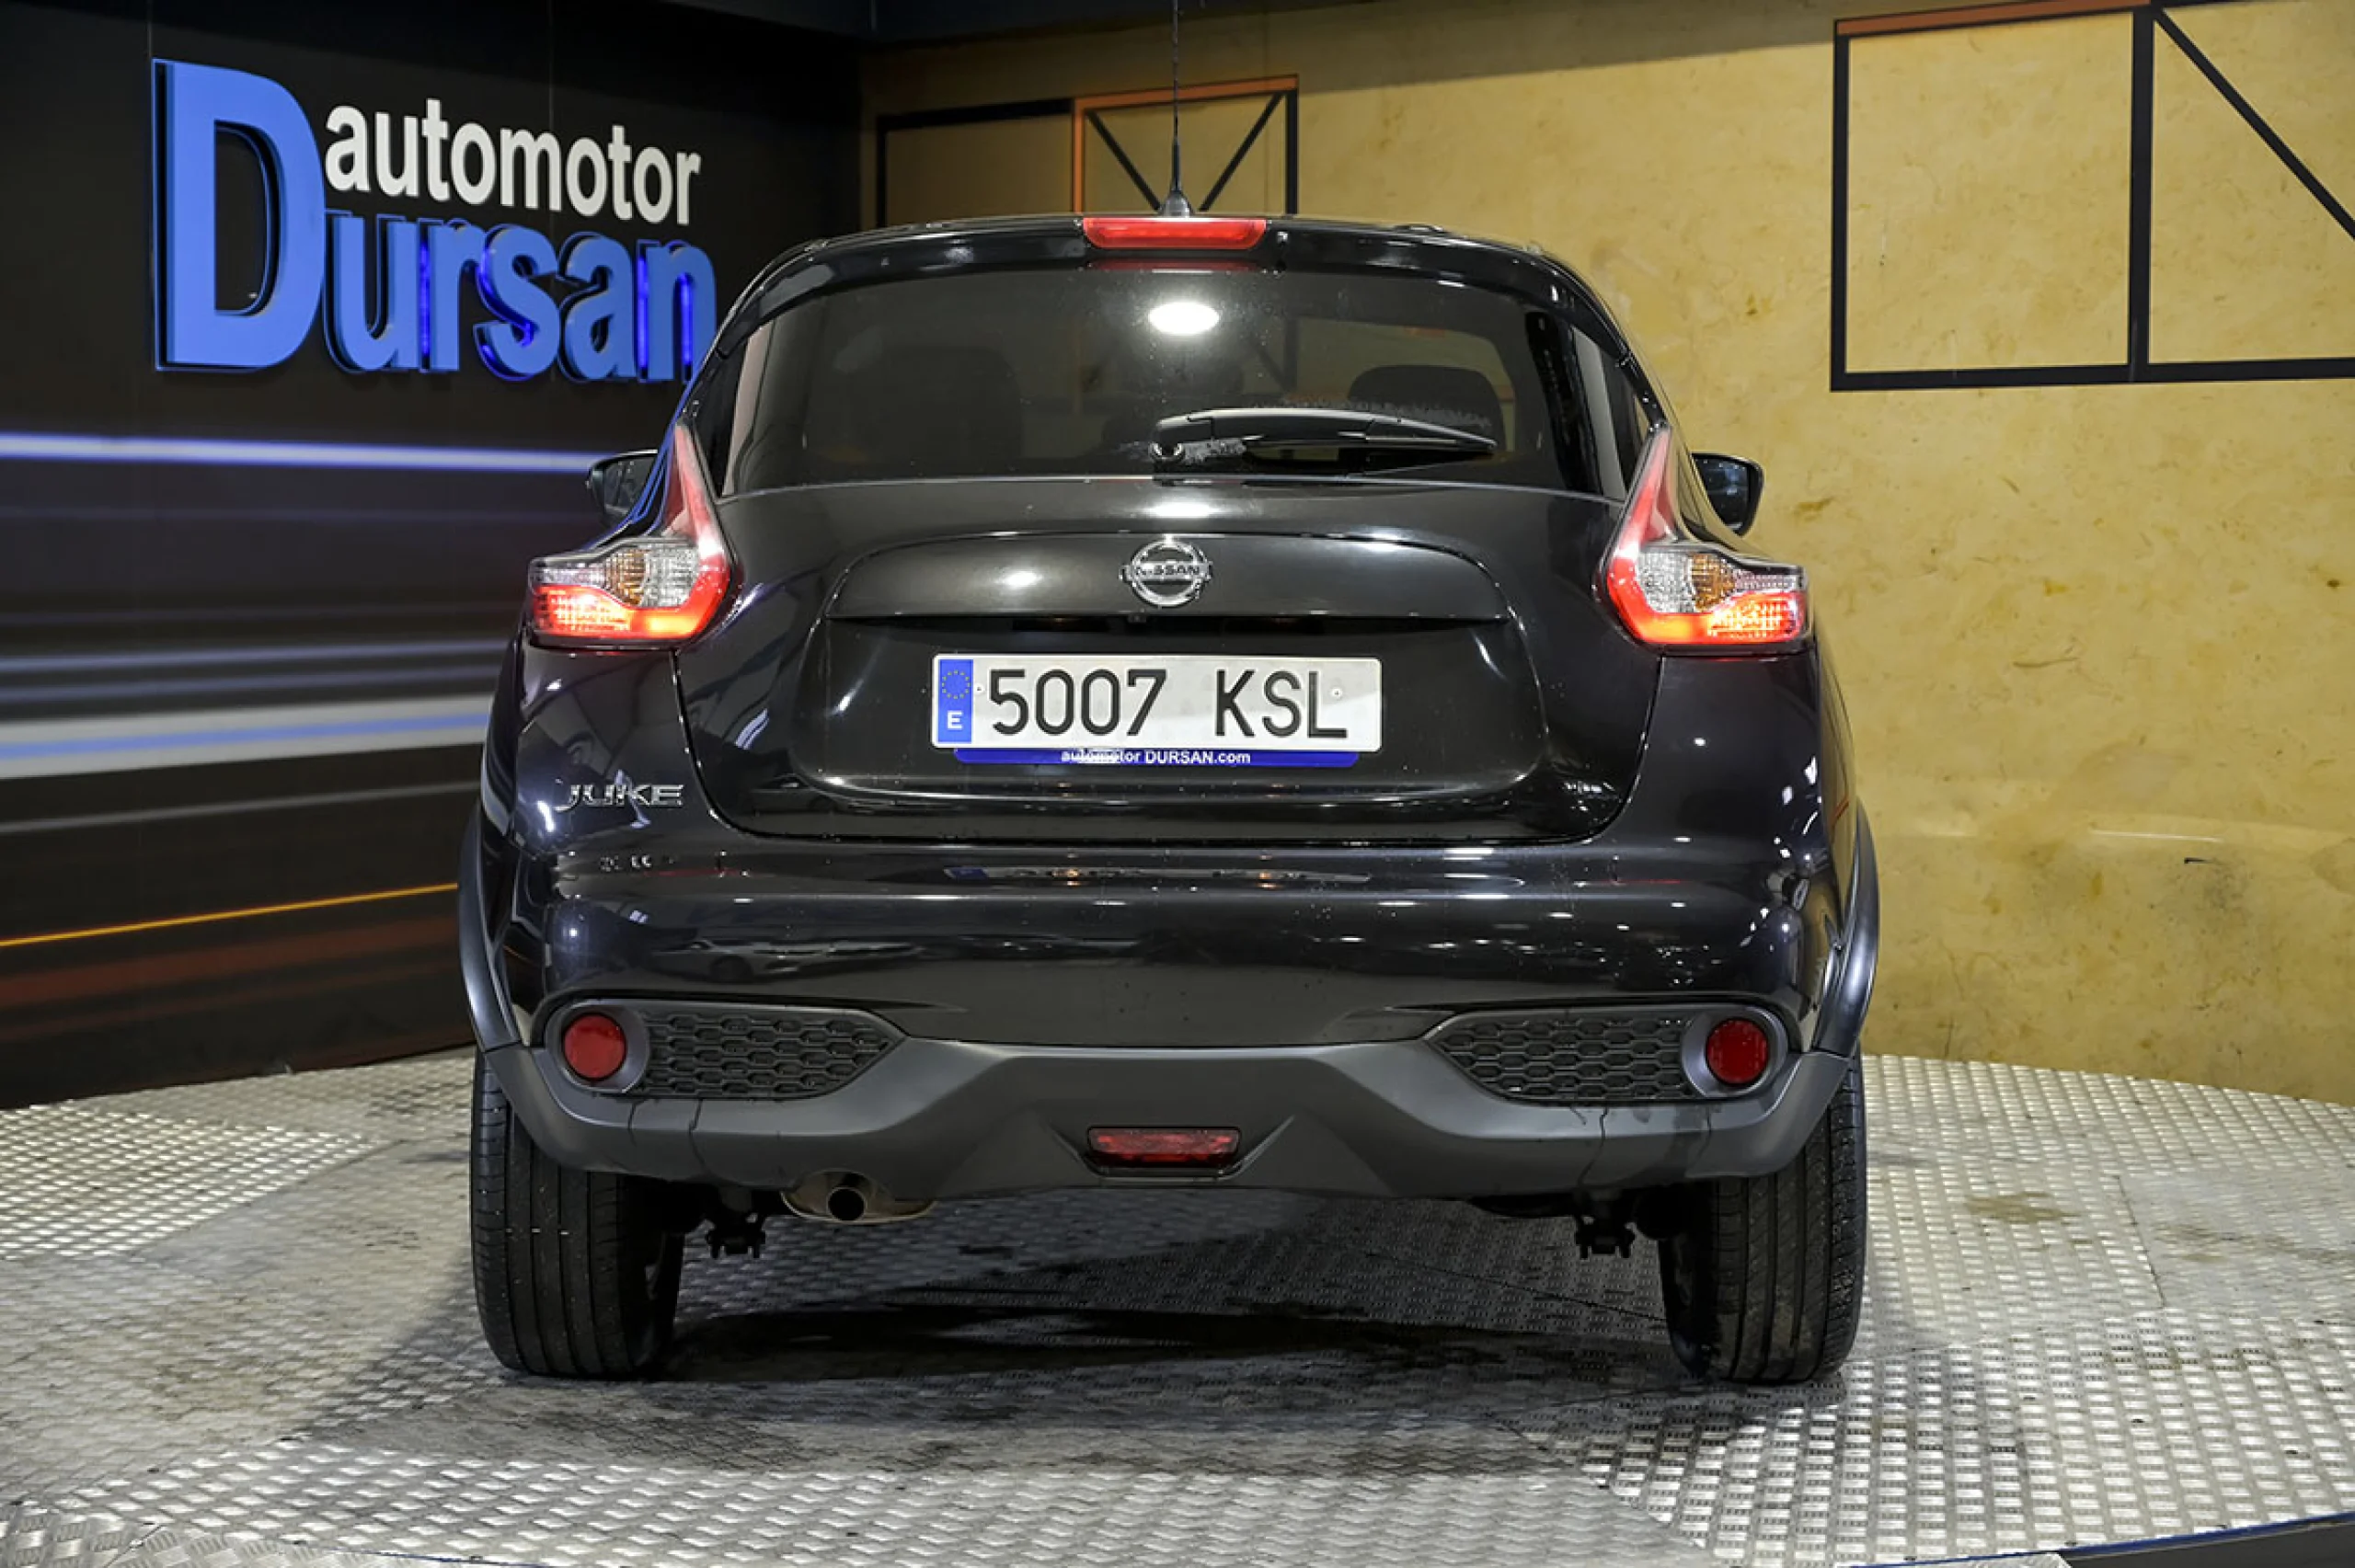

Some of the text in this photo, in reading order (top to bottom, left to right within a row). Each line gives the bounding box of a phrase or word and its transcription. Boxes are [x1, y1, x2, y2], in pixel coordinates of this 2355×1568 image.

[325, 98, 701, 224] automotor
[152, 57, 717, 382] Dursan
[947, 711, 963, 729] E
[990, 669, 1347, 738] 5007 KSL
[1145, 750, 1251, 765] DURSAN.com
[554, 784, 684, 811] JUKE
